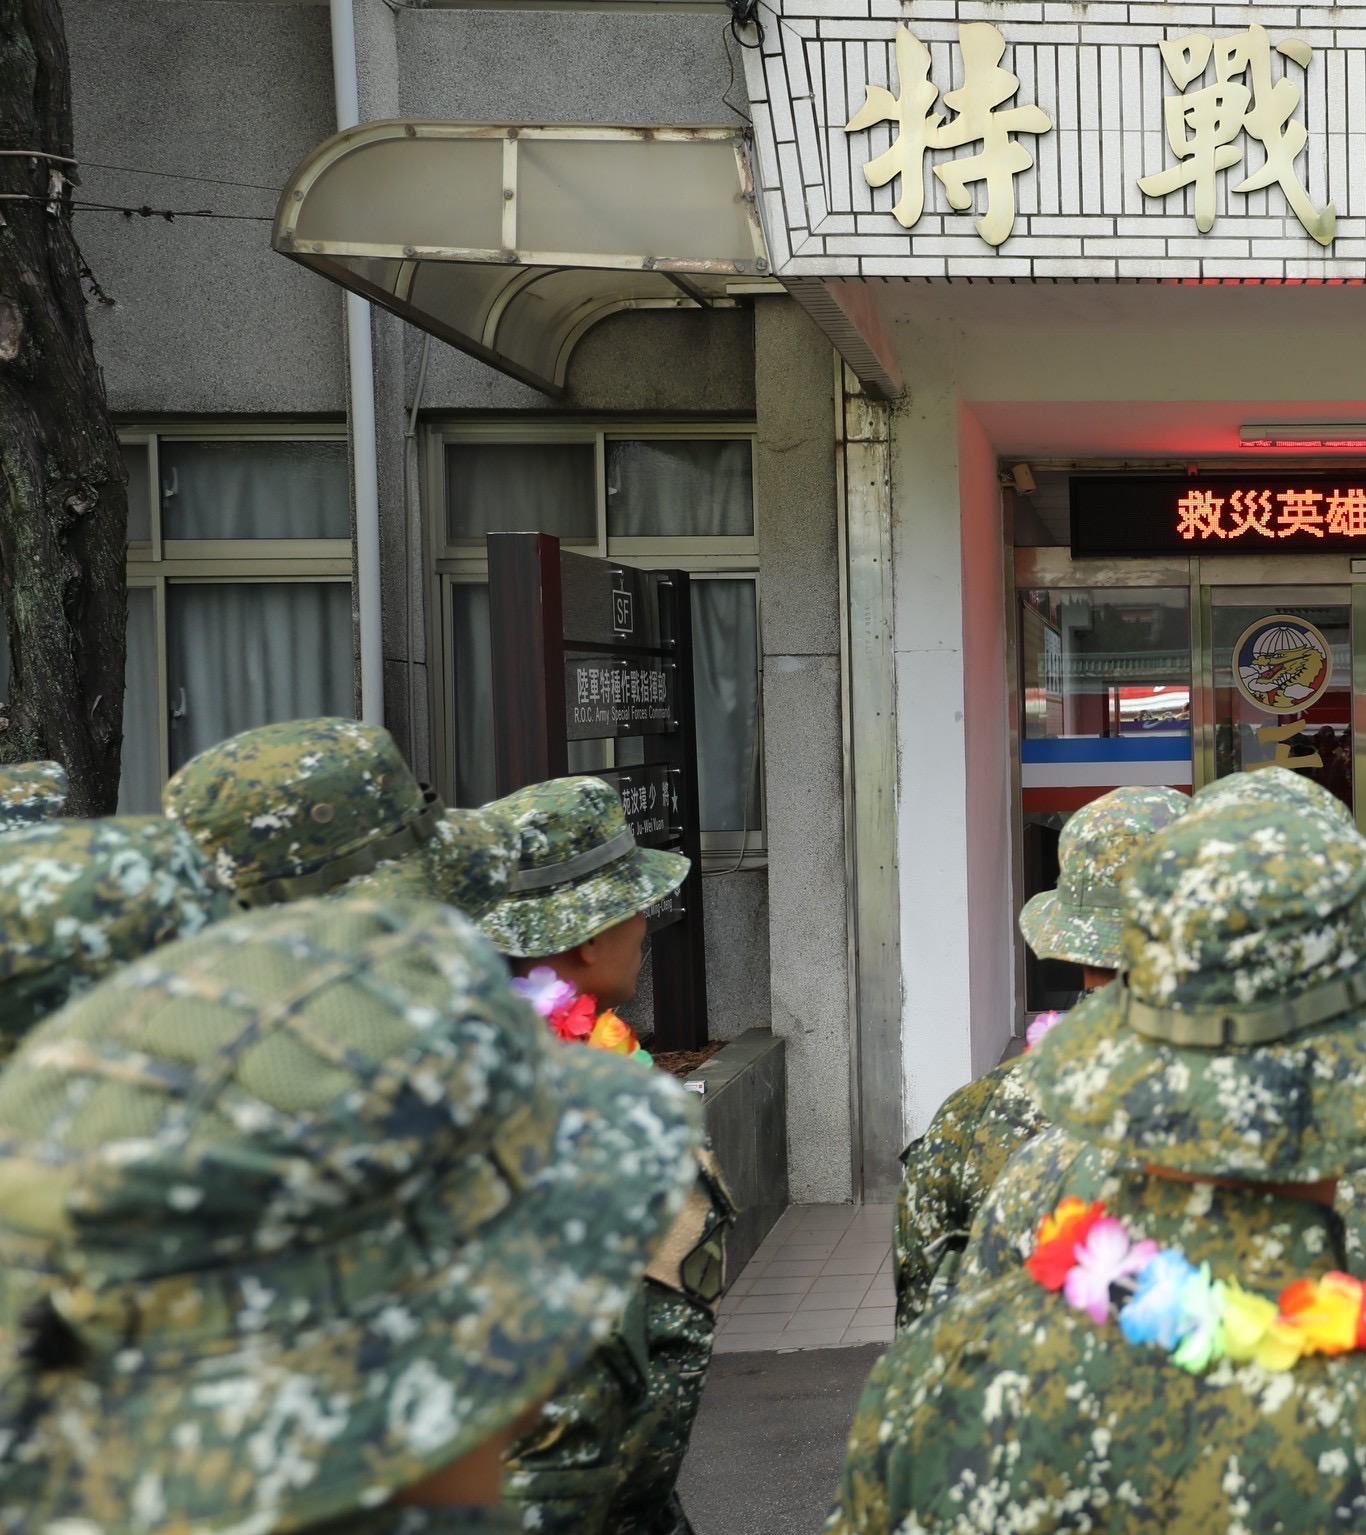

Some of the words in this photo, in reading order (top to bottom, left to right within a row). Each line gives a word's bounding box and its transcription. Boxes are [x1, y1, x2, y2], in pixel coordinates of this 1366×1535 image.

[616, 598, 629, 624] SF
[577, 668, 667, 704] 陸軍特種作戰指揮部
[574, 706, 594, 723] R.O.C.
[595, 706, 610, 725] Army
[611, 705, 630, 724] Special
[631, 705, 648, 720] Forces
[648, 704, 671, 719] Command
